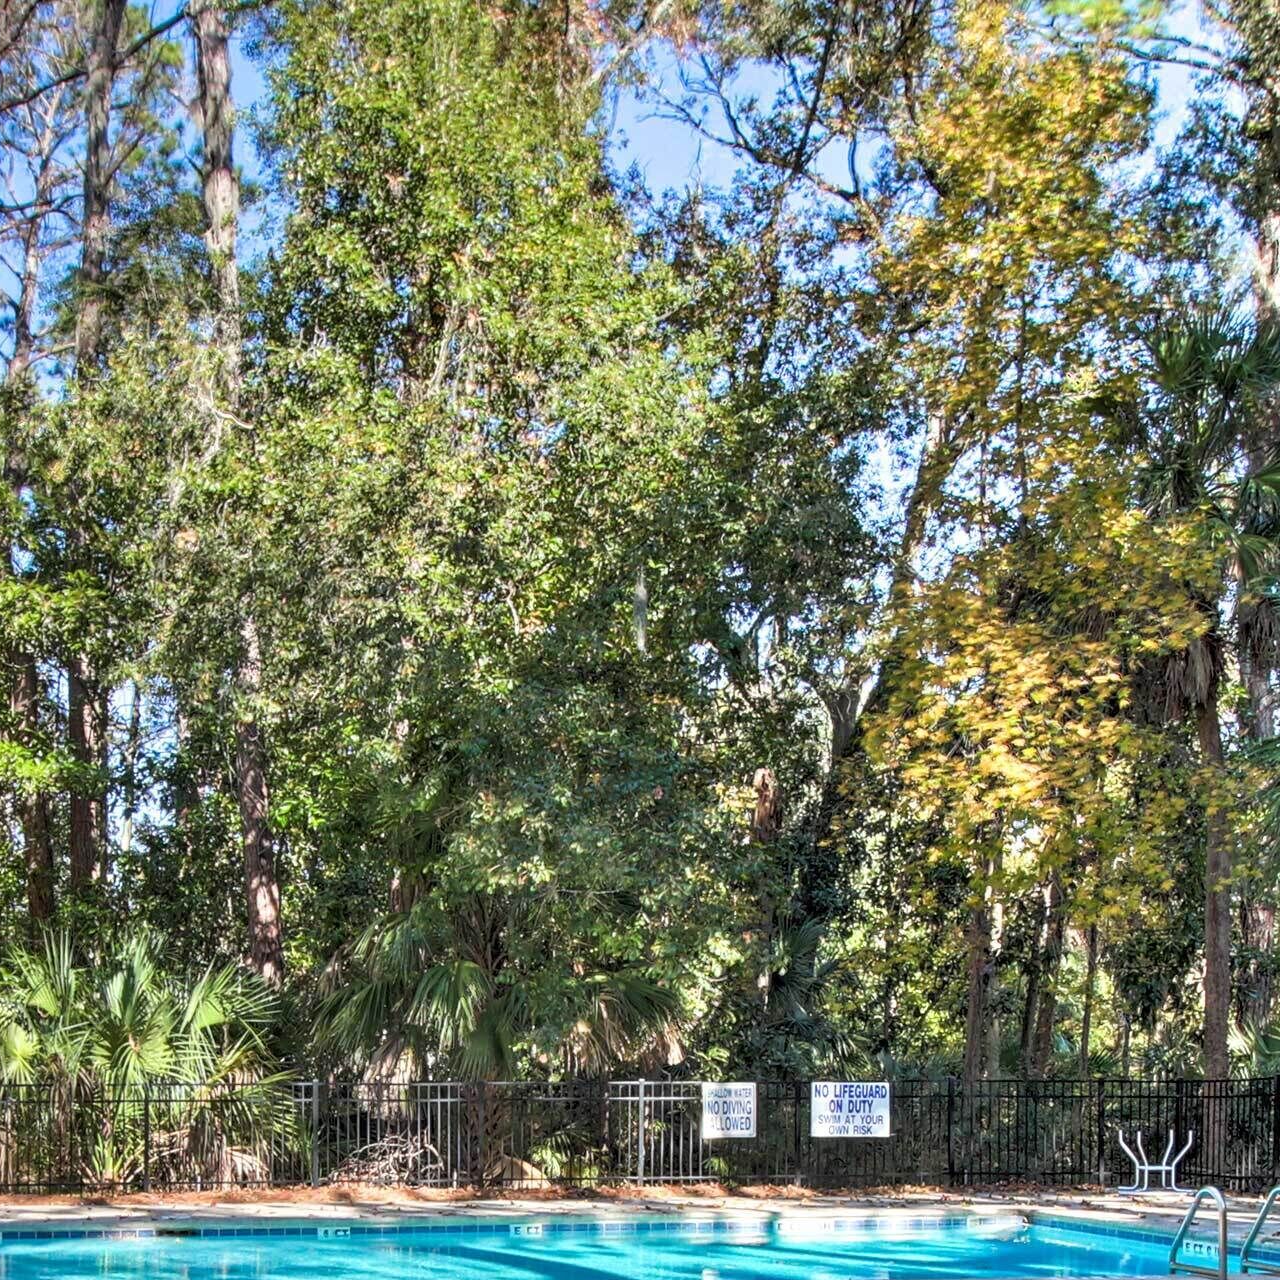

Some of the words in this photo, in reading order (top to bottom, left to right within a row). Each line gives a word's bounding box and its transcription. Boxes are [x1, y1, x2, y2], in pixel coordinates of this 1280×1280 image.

[734, 1088, 751, 1097] WATER
[815, 1085, 829, 1098] NO
[834, 1085, 887, 1098] LIFEGUARD
[707, 1101, 719, 1115] NO
[722, 1101, 752, 1115] DIVING
[829, 1100, 842, 1113] ON
[848, 1100, 873, 1113] DUTY
[818, 1115, 840, 1125] SWIM
[844, 1115, 856, 1124] AT
[860, 1115, 884, 1125] YOUR
[828, 1125, 849, 1135] OWN
[853, 1126, 873, 1135] RISK
